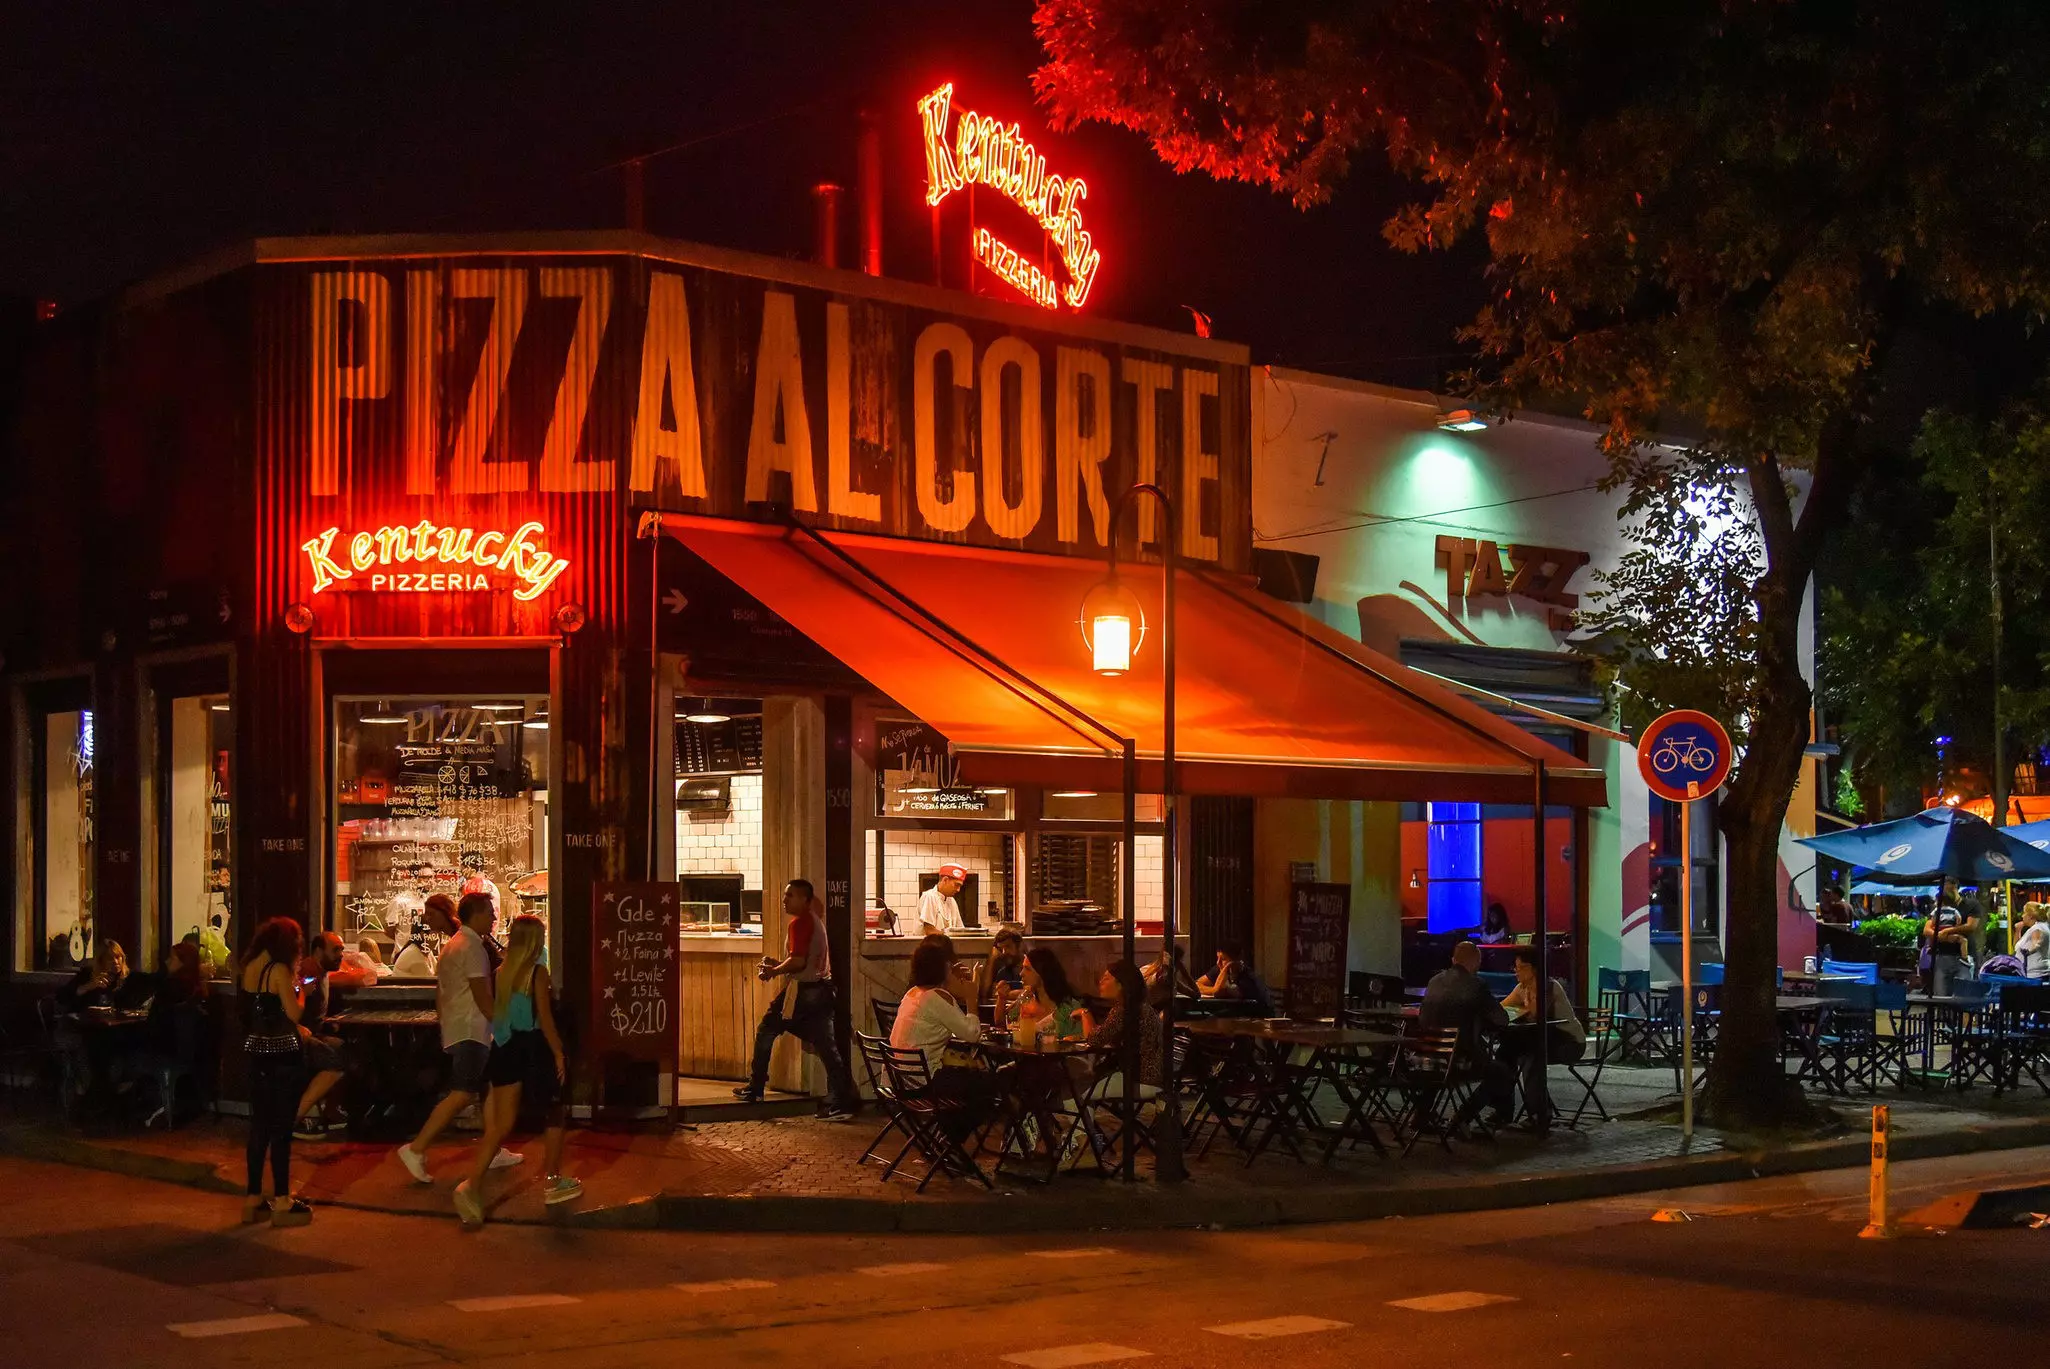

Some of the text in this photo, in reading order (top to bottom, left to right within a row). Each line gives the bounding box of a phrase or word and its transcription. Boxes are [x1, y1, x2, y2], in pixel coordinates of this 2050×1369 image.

[917, 83, 1101, 308] Kentucky
[973, 228, 1058, 310] PIZZERIA
[308, 266, 1221, 563] PIZZA AL CORTE
[301, 519, 570, 602] Kentucky
[371, 573, 489, 592] PIZZERIA
[403, 706, 504, 745] PIZZA
[565, 833, 617, 847] TAKE ONE
[617, 895, 655, 923] Gde
[610, 999, 667, 1036] $210
